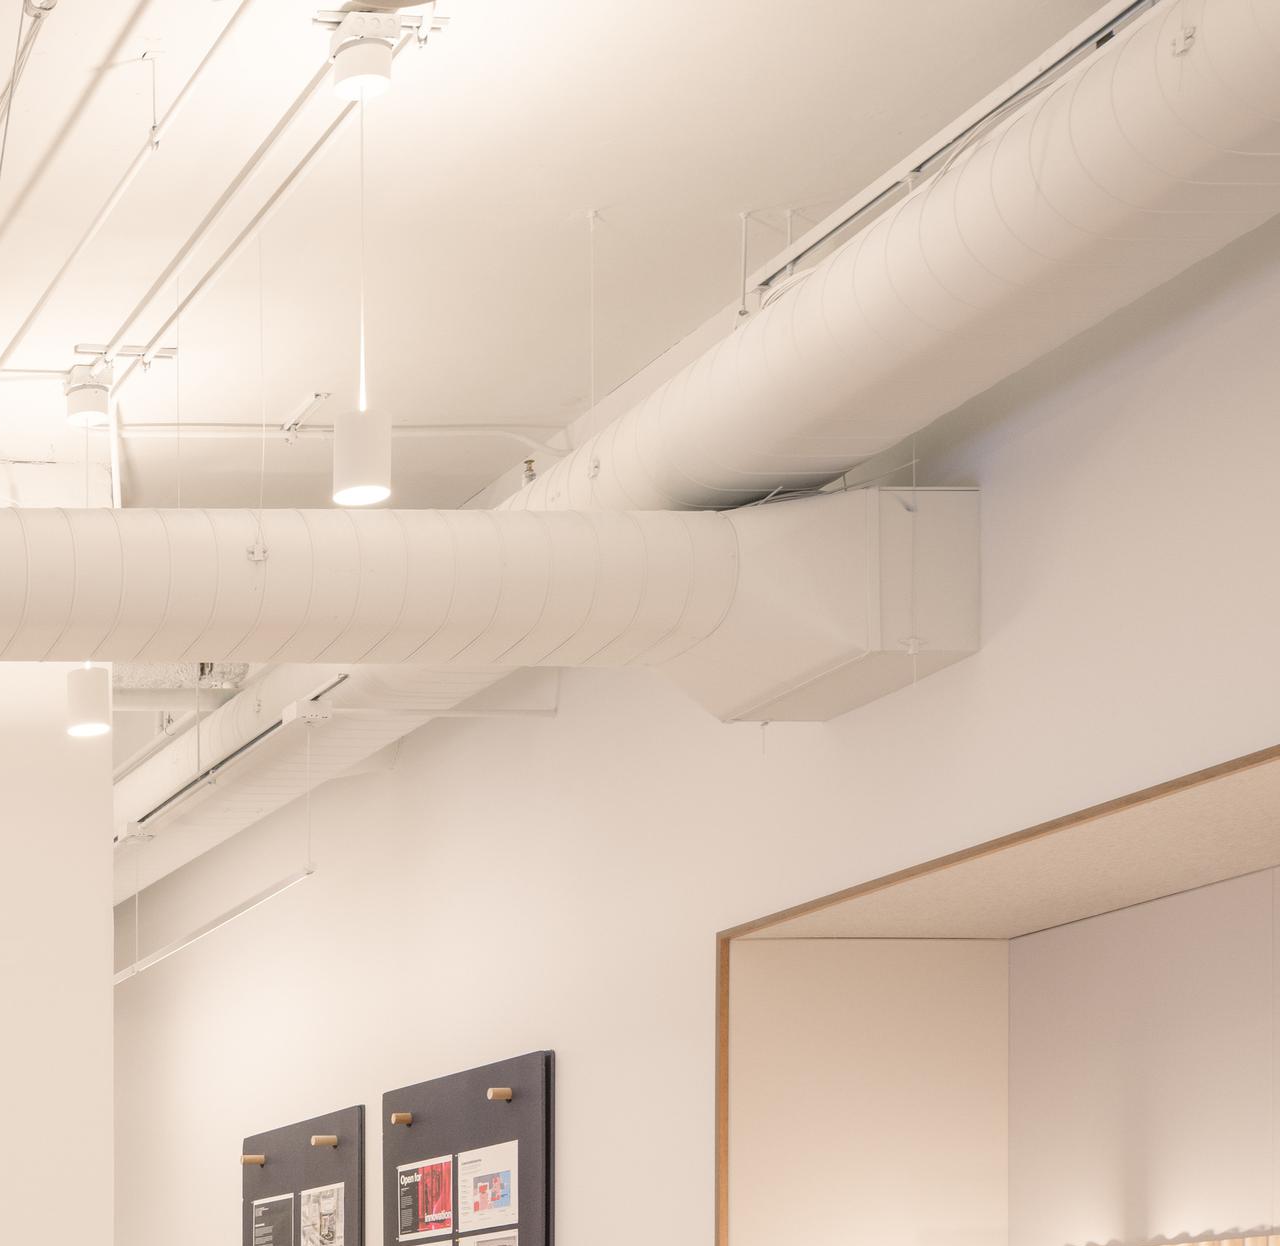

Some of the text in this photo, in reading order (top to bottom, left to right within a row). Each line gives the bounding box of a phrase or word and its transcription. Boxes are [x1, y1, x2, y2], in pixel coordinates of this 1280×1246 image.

[400, 1172, 422, 1186] Open for
[424, 1210, 451, 1223] innovation
